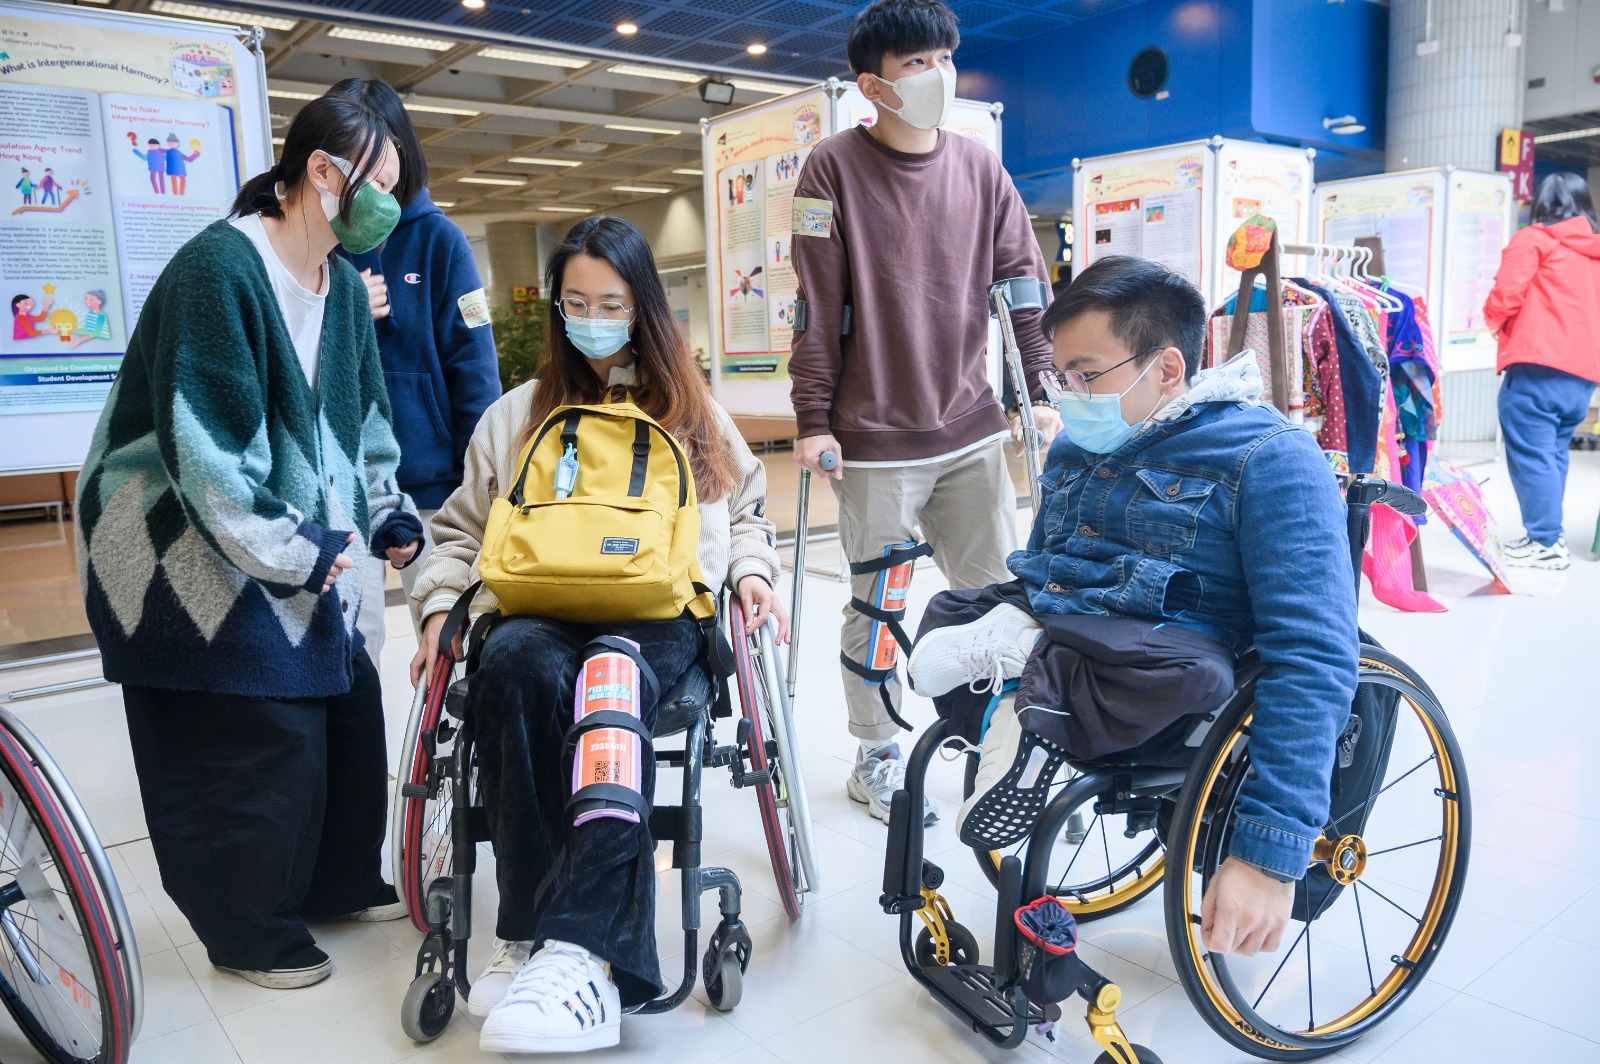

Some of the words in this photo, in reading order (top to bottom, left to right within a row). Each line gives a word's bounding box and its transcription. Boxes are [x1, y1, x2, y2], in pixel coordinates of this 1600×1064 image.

[0, 63, 26, 75] What
[27, 60, 36, 69] is
[36, 59, 119, 71] Intergenerational
[121, 64, 170, 86] Harmony?
[110, 103, 129, 112] How
[139, 105, 160, 114] foster
[111, 113, 173, 125] Intergenerational
[174, 118, 210, 128] Harmony?
[33, 144, 57, 153] Aging
[59, 145, 82, 153] Trend
[1521, 137, 1531, 161] F
[0, 152, 21, 161] Hong
[22, 153, 43, 162] Kong
[1519, 171, 1530, 195] K
[24, 365, 59, 374] Organised
[70, 364, 108, 372] Counselling
[66, 374, 110, 382] Development
